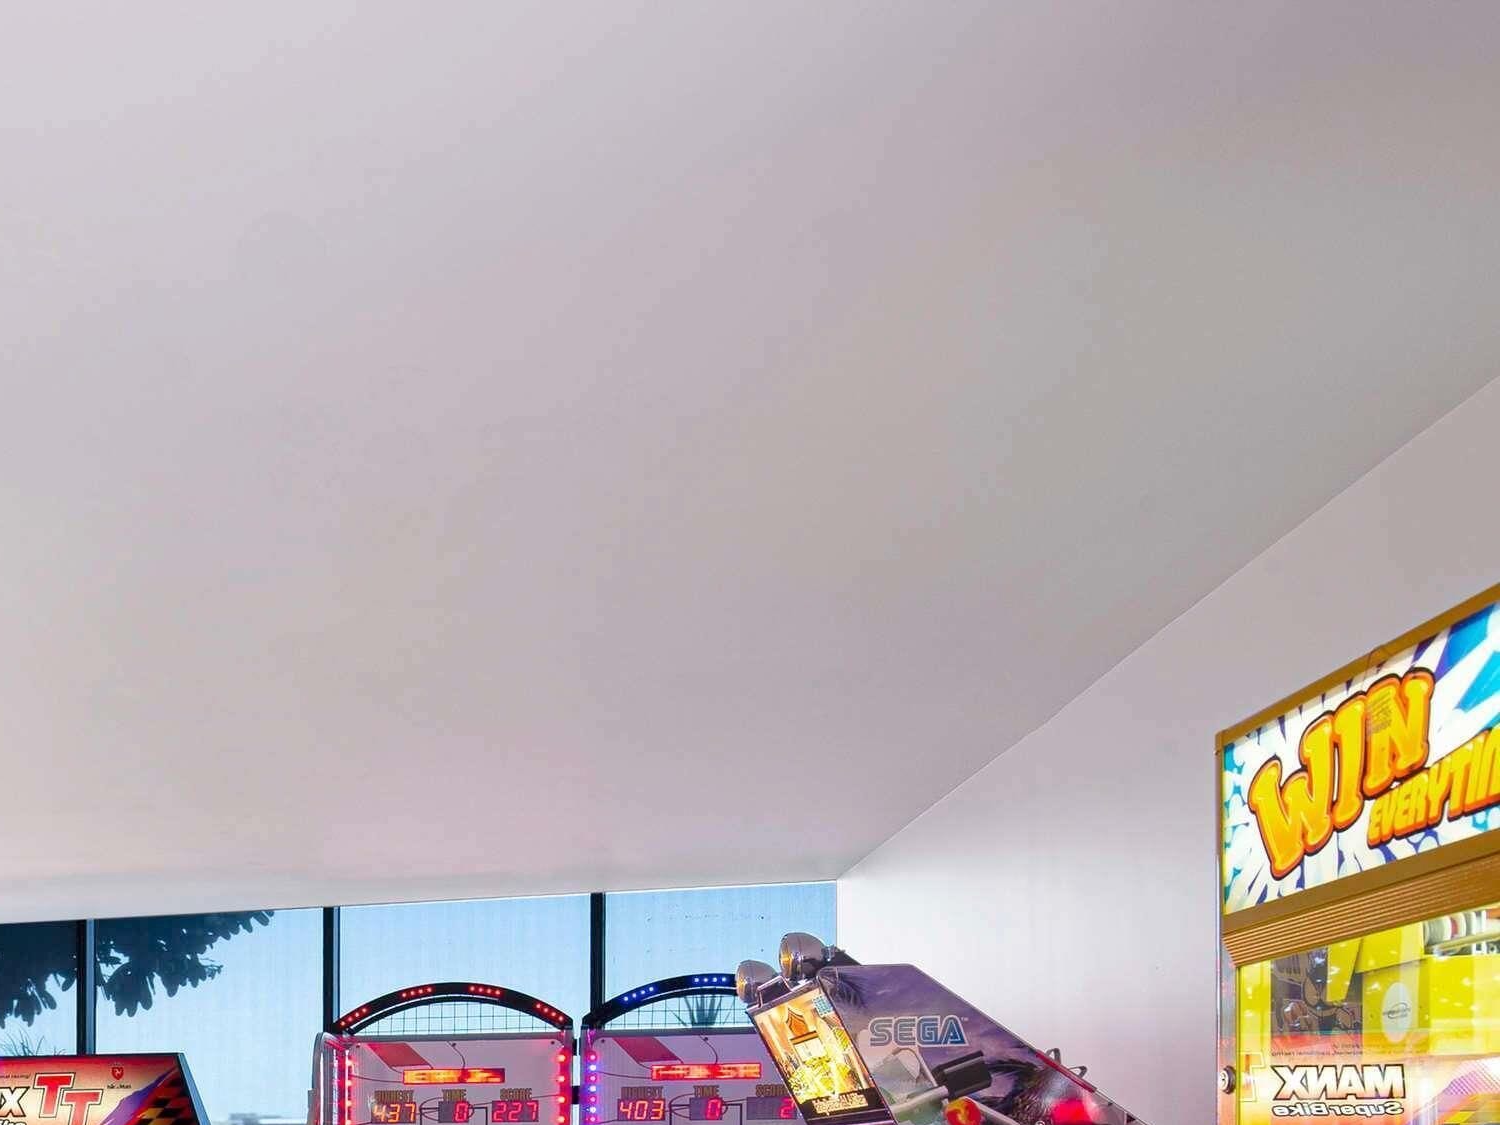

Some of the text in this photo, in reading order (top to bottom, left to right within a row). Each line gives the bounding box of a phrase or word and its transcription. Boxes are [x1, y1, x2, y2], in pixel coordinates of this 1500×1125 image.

[1249, 667, 1436, 880] WIN
[869, 1016, 967, 1047] SEGA
[500, 1088, 533, 1101] SCORE
[373, 1102, 538, 1122] 437 0 227
[619, 1101, 664, 1120] 403
[707, 1100, 721, 1119] 0
